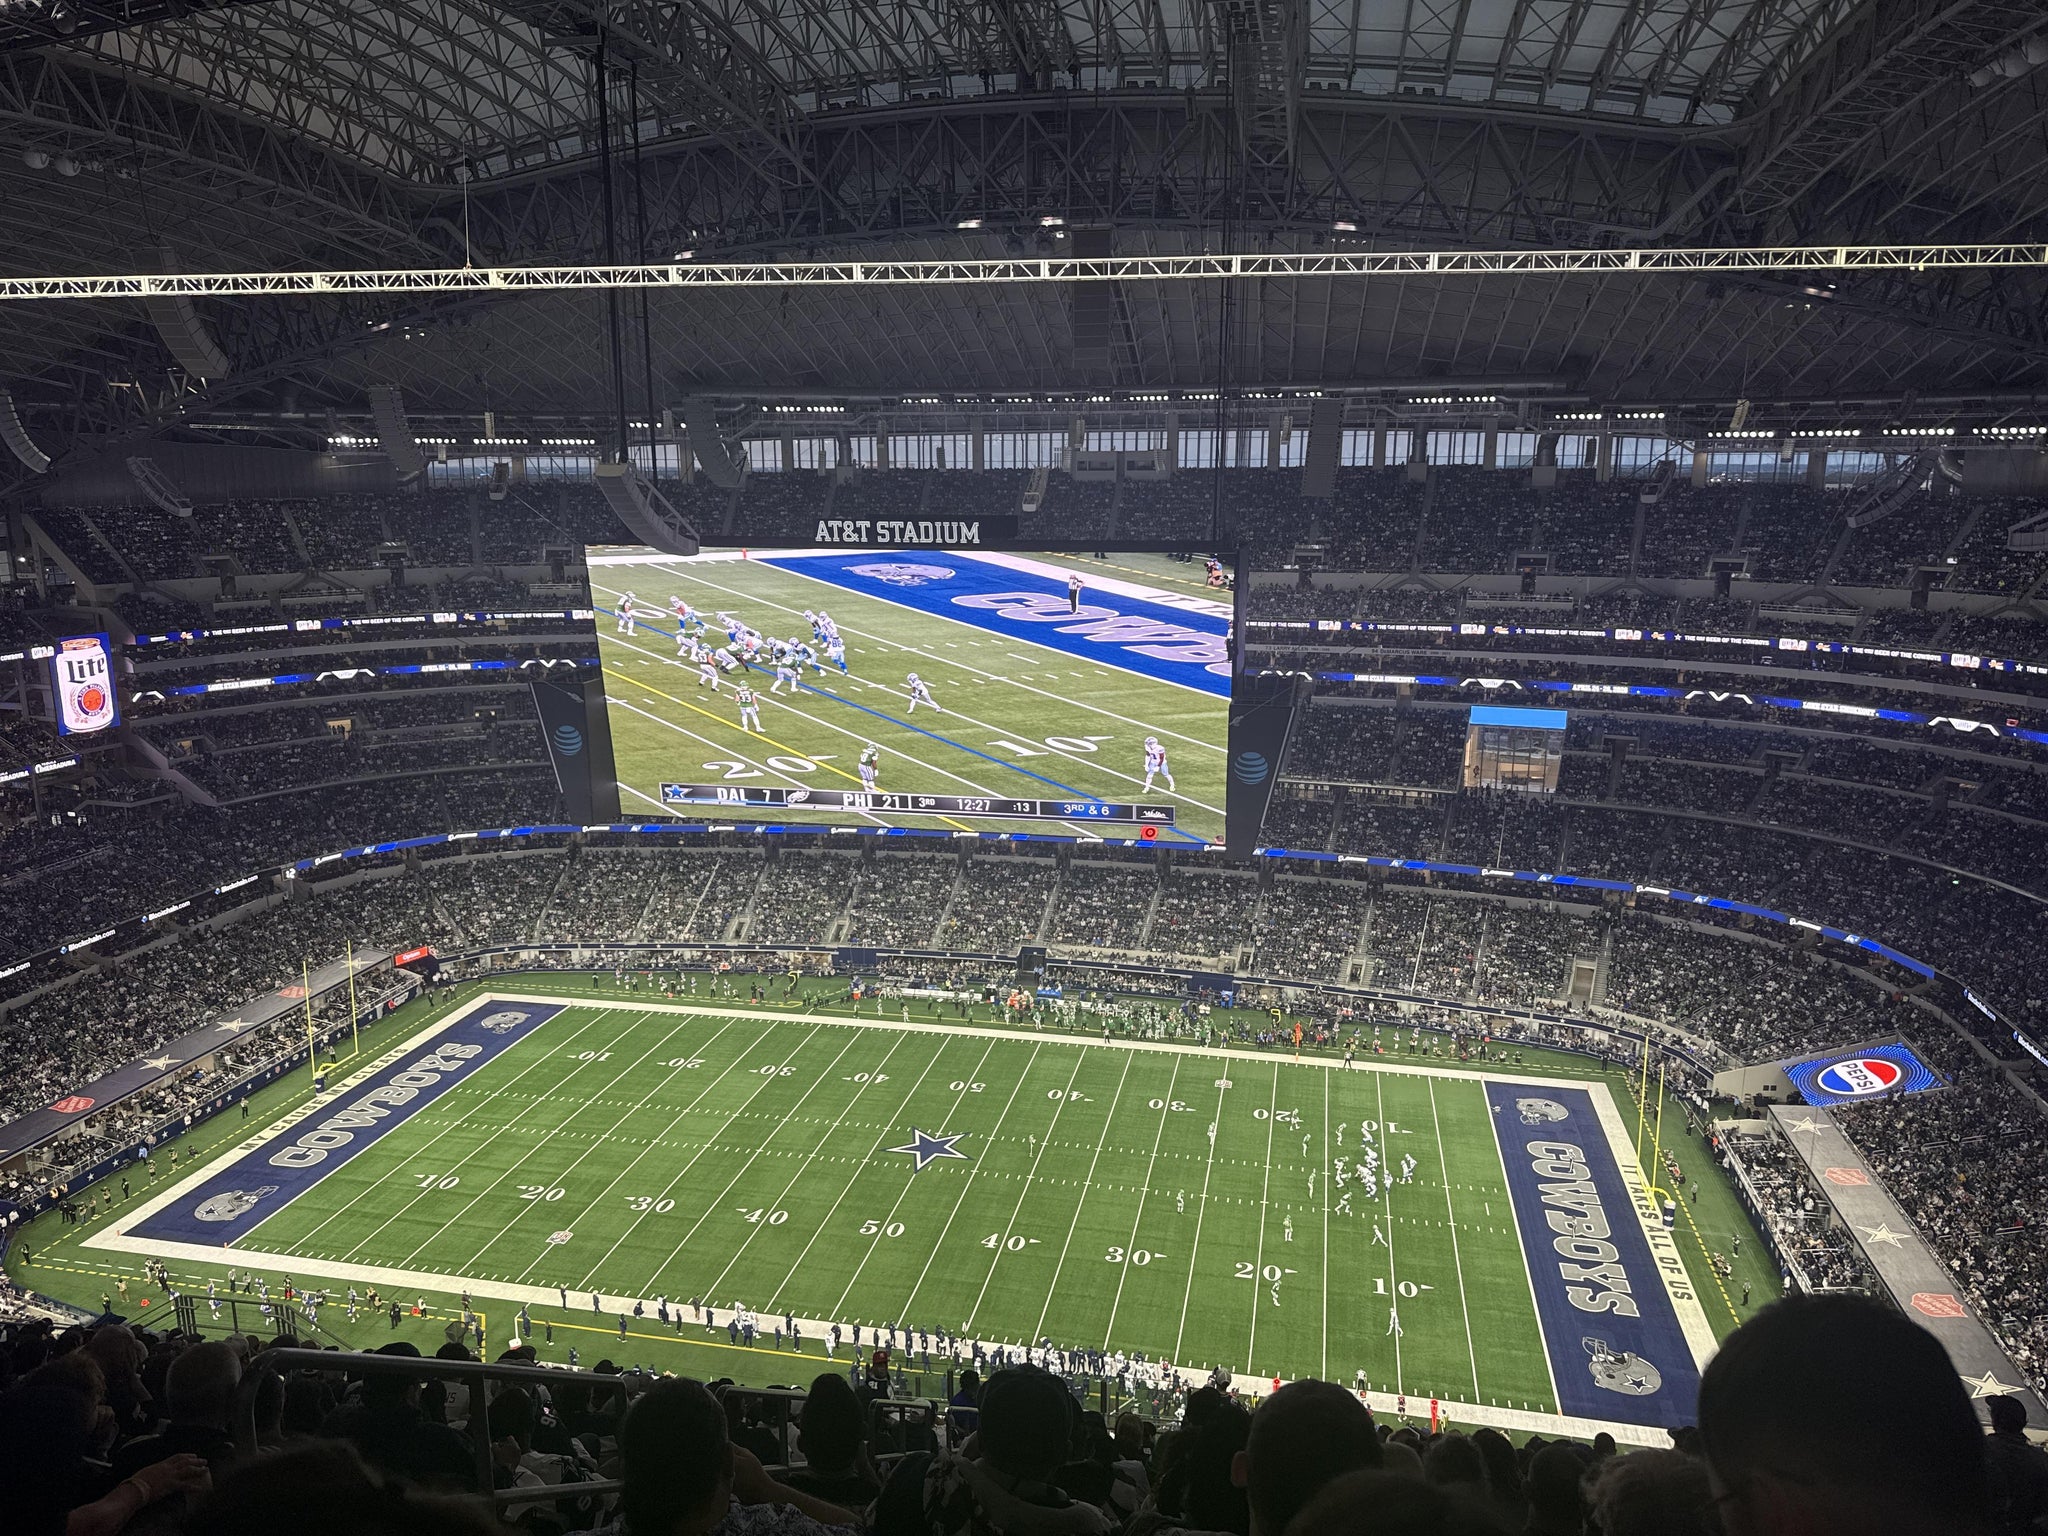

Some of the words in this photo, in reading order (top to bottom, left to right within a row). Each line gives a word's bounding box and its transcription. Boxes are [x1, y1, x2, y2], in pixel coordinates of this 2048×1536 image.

[816, 520, 868, 542] AT&T
[878, 521, 980, 544] STADIUM
[65, 657, 104, 684] Lite
[986, 736, 1098, 756] 10
[702, 756, 818, 778] 20
[717, 788, 748, 801] DAL
[762, 790, 771, 802] 7
[843, 794, 872, 808] PHI
[882, 795, 900, 808] 21
[918, 797, 935, 807] 3RD
[956, 799, 990, 811] 12:27
[1013, 802, 1030, 812] :13
[1064, 804, 1084, 814] 3RD
[1088, 805, 1098, 815] &
[1101, 805, 1109, 816] 6
[221, 875, 258, 893] Blockchain.com
[149, 901, 190, 921] Blockchain.com
[68, 929, 116, 951] Blockchain.com
[579, 1050, 614, 1062] 10
[669, 1057, 705, 1069] 20
[760, 1064, 797, 1076] 30
[854, 1072, 890, 1084] 40
[1842, 1063, 1876, 1090] PEPSI
[949, 1080, 986, 1092] 50
[240, 1134, 270, 1151] MY
[270, 1097, 326, 1132] CAUSE
[329, 1082, 351, 1096] MY
[353, 1048, 408, 1080] CLEATS
[1047, 1089, 1084, 1101] 40
[269, 1043, 483, 1167] COWBOYS
[1148, 1099, 1186, 1112] 30
[1253, 1108, 1291, 1122] 20
[1361, 1119, 1401, 1134] 10
[418, 1173, 460, 1190] 10
[520, 1186, 565, 1202] 20
[630, 1197, 675, 1213] 30
[744, 1209, 789, 1225] 40
[859, 1220, 905, 1237] 50
[1527, 1140, 1640, 1317] COWBOYS
[1646, 1224, 1668, 1249] ALL
[980, 1234, 1028, 1251] 40
[1105, 1247, 1151, 1266] 30
[1658, 1256, 1682, 1274] OF
[1234, 1262, 1284, 1281] 20
[1373, 1278, 1418, 1297] 10
[1668, 1280, 1693, 1301] US
